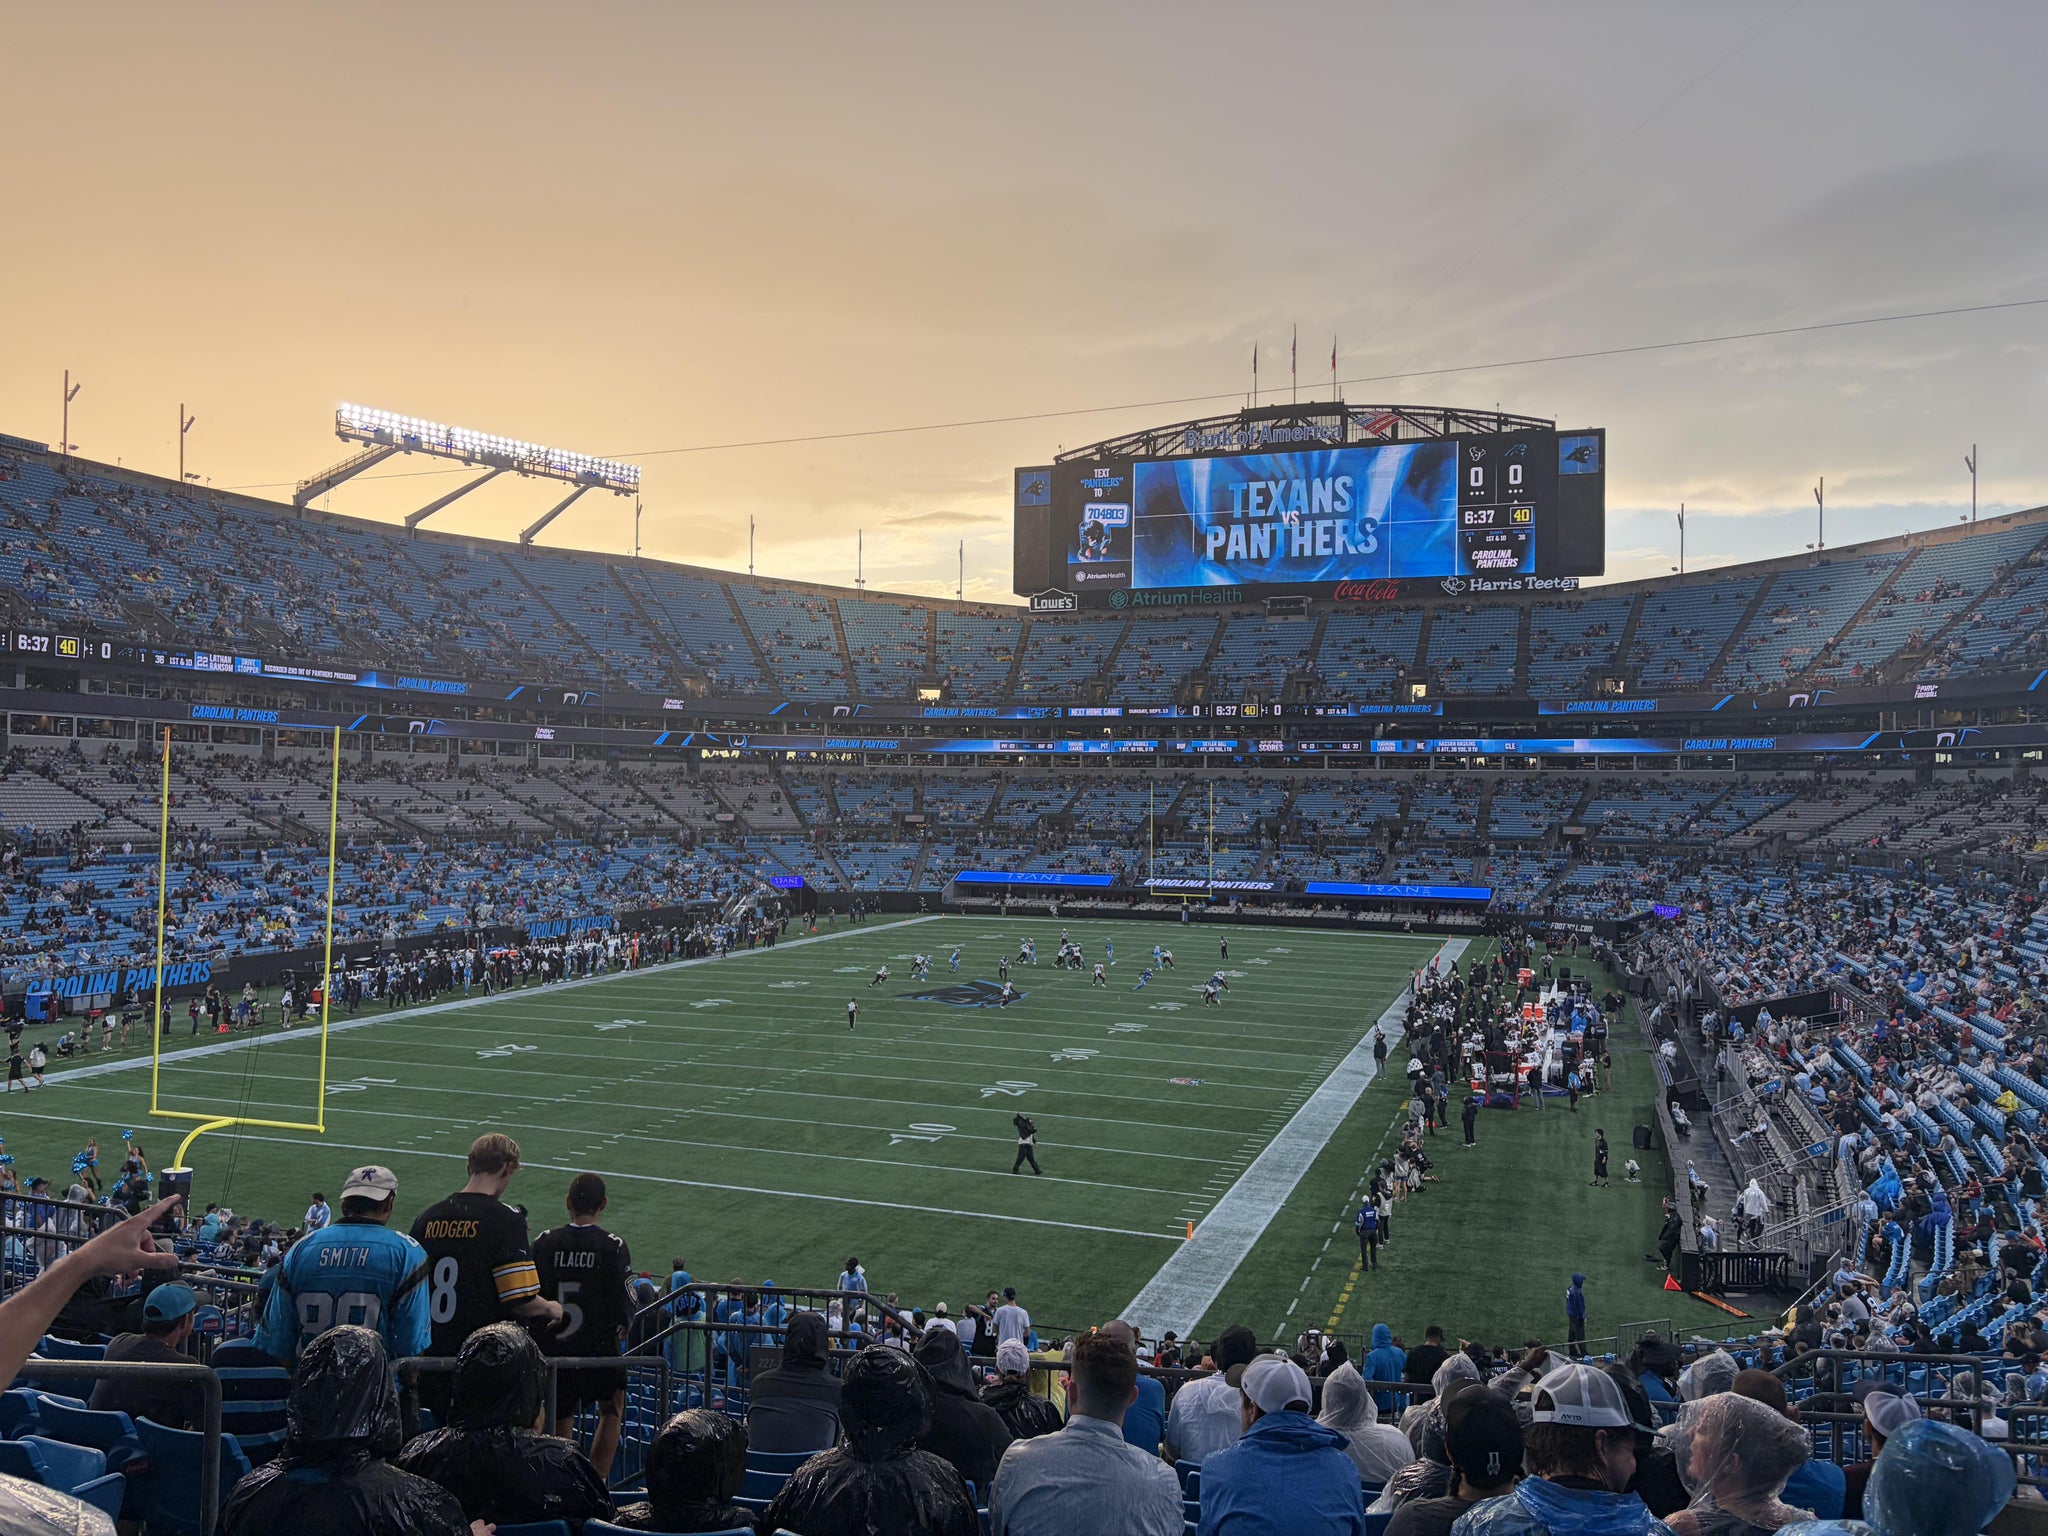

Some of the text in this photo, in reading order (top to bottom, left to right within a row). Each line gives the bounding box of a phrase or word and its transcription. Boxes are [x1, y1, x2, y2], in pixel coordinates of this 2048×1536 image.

[1184, 422, 1343, 449] Bank of America
[1094, 468, 1110, 478] TEXT
[1470, 466, 1483, 487] 0
[1509, 464, 1523, 485] 0
[1094, 488, 1102, 497] TO
[1228, 476, 1354, 519] TEXANS
[1088, 508, 1125, 520] 704803
[1281, 510, 1300, 526] VS
[1464, 510, 1495, 525] 6:37
[1513, 508, 1530, 522] 40
[1206, 517, 1378, 561] PANTHERS
[1472, 549, 1512, 560] CAROLINA
[1476, 557, 1518, 569] PANTHERS
[1333, 578, 1400, 602] Coca-Cola
[1469, 576, 1578, 592] Harris Teeter
[1034, 596, 1073, 610] LOWE'S
[1132, 588, 1242, 606] Atrium Health
[18, 634, 49, 652] 6:37
[60, 639, 76, 655] 40
[101, 642, 111, 659] 0
[141, 653, 145, 663] 1
[169, 656, 179, 665] 1ST
[179, 657, 185, 666] &
[197, 656, 208, 667] 22
[209, 654, 232, 664] LATHAN
[209, 662, 234, 672] RANSOM
[264, 664, 287, 674] RECORDED
[397, 677, 466, 693] CAROLINA PANTHERS
[924, 707, 998, 717] CAROLINA PANTHERS
[1071, 707, 1085, 716] NEXT
[1086, 707, 1103, 716] HOME
[1103, 707, 1120, 716] GAME
[1193, 705, 1200, 716] 0
[1216, 705, 1237, 716] 6:37
[1244, 705, 1256, 716] 40
[1274, 704, 1281, 716] 0
[1359, 704, 1432, 714] CAROLINA PANTHERS
[1567, 699, 1656, 712] CAROLINA PANTHERS
[192, 705, 279, 722] CAROLINA PANTHERS
[825, 739, 898, 749] CAROLINA PANTHERS
[1258, 744, 1284, 752] SCORES
[1416, 742, 1425, 750] NE
[1505, 742, 1516, 750] CLE
[1684, 738, 1775, 750] CAROLINA PANTHERS
[1144, 878, 1275, 890] CAROLINA PANTHERS
[123, 960, 213, 991] PANTHERS
[476, 1044, 538, 1057] 20
[1050, 1047, 1100, 1060] 30
[980, 1080, 1038, 1097] 20
[889, 1122, 957, 1143] 10
[424, 1220, 479, 1239] RODGERS
[319, 1247, 369, 1267] SMITH
[554, 1251, 595, 1268] FLACCO
[431, 1256, 459, 1324] 8
[555, 1281, 584, 1340] 5
[1560, 1413, 1582, 1421] AVID
